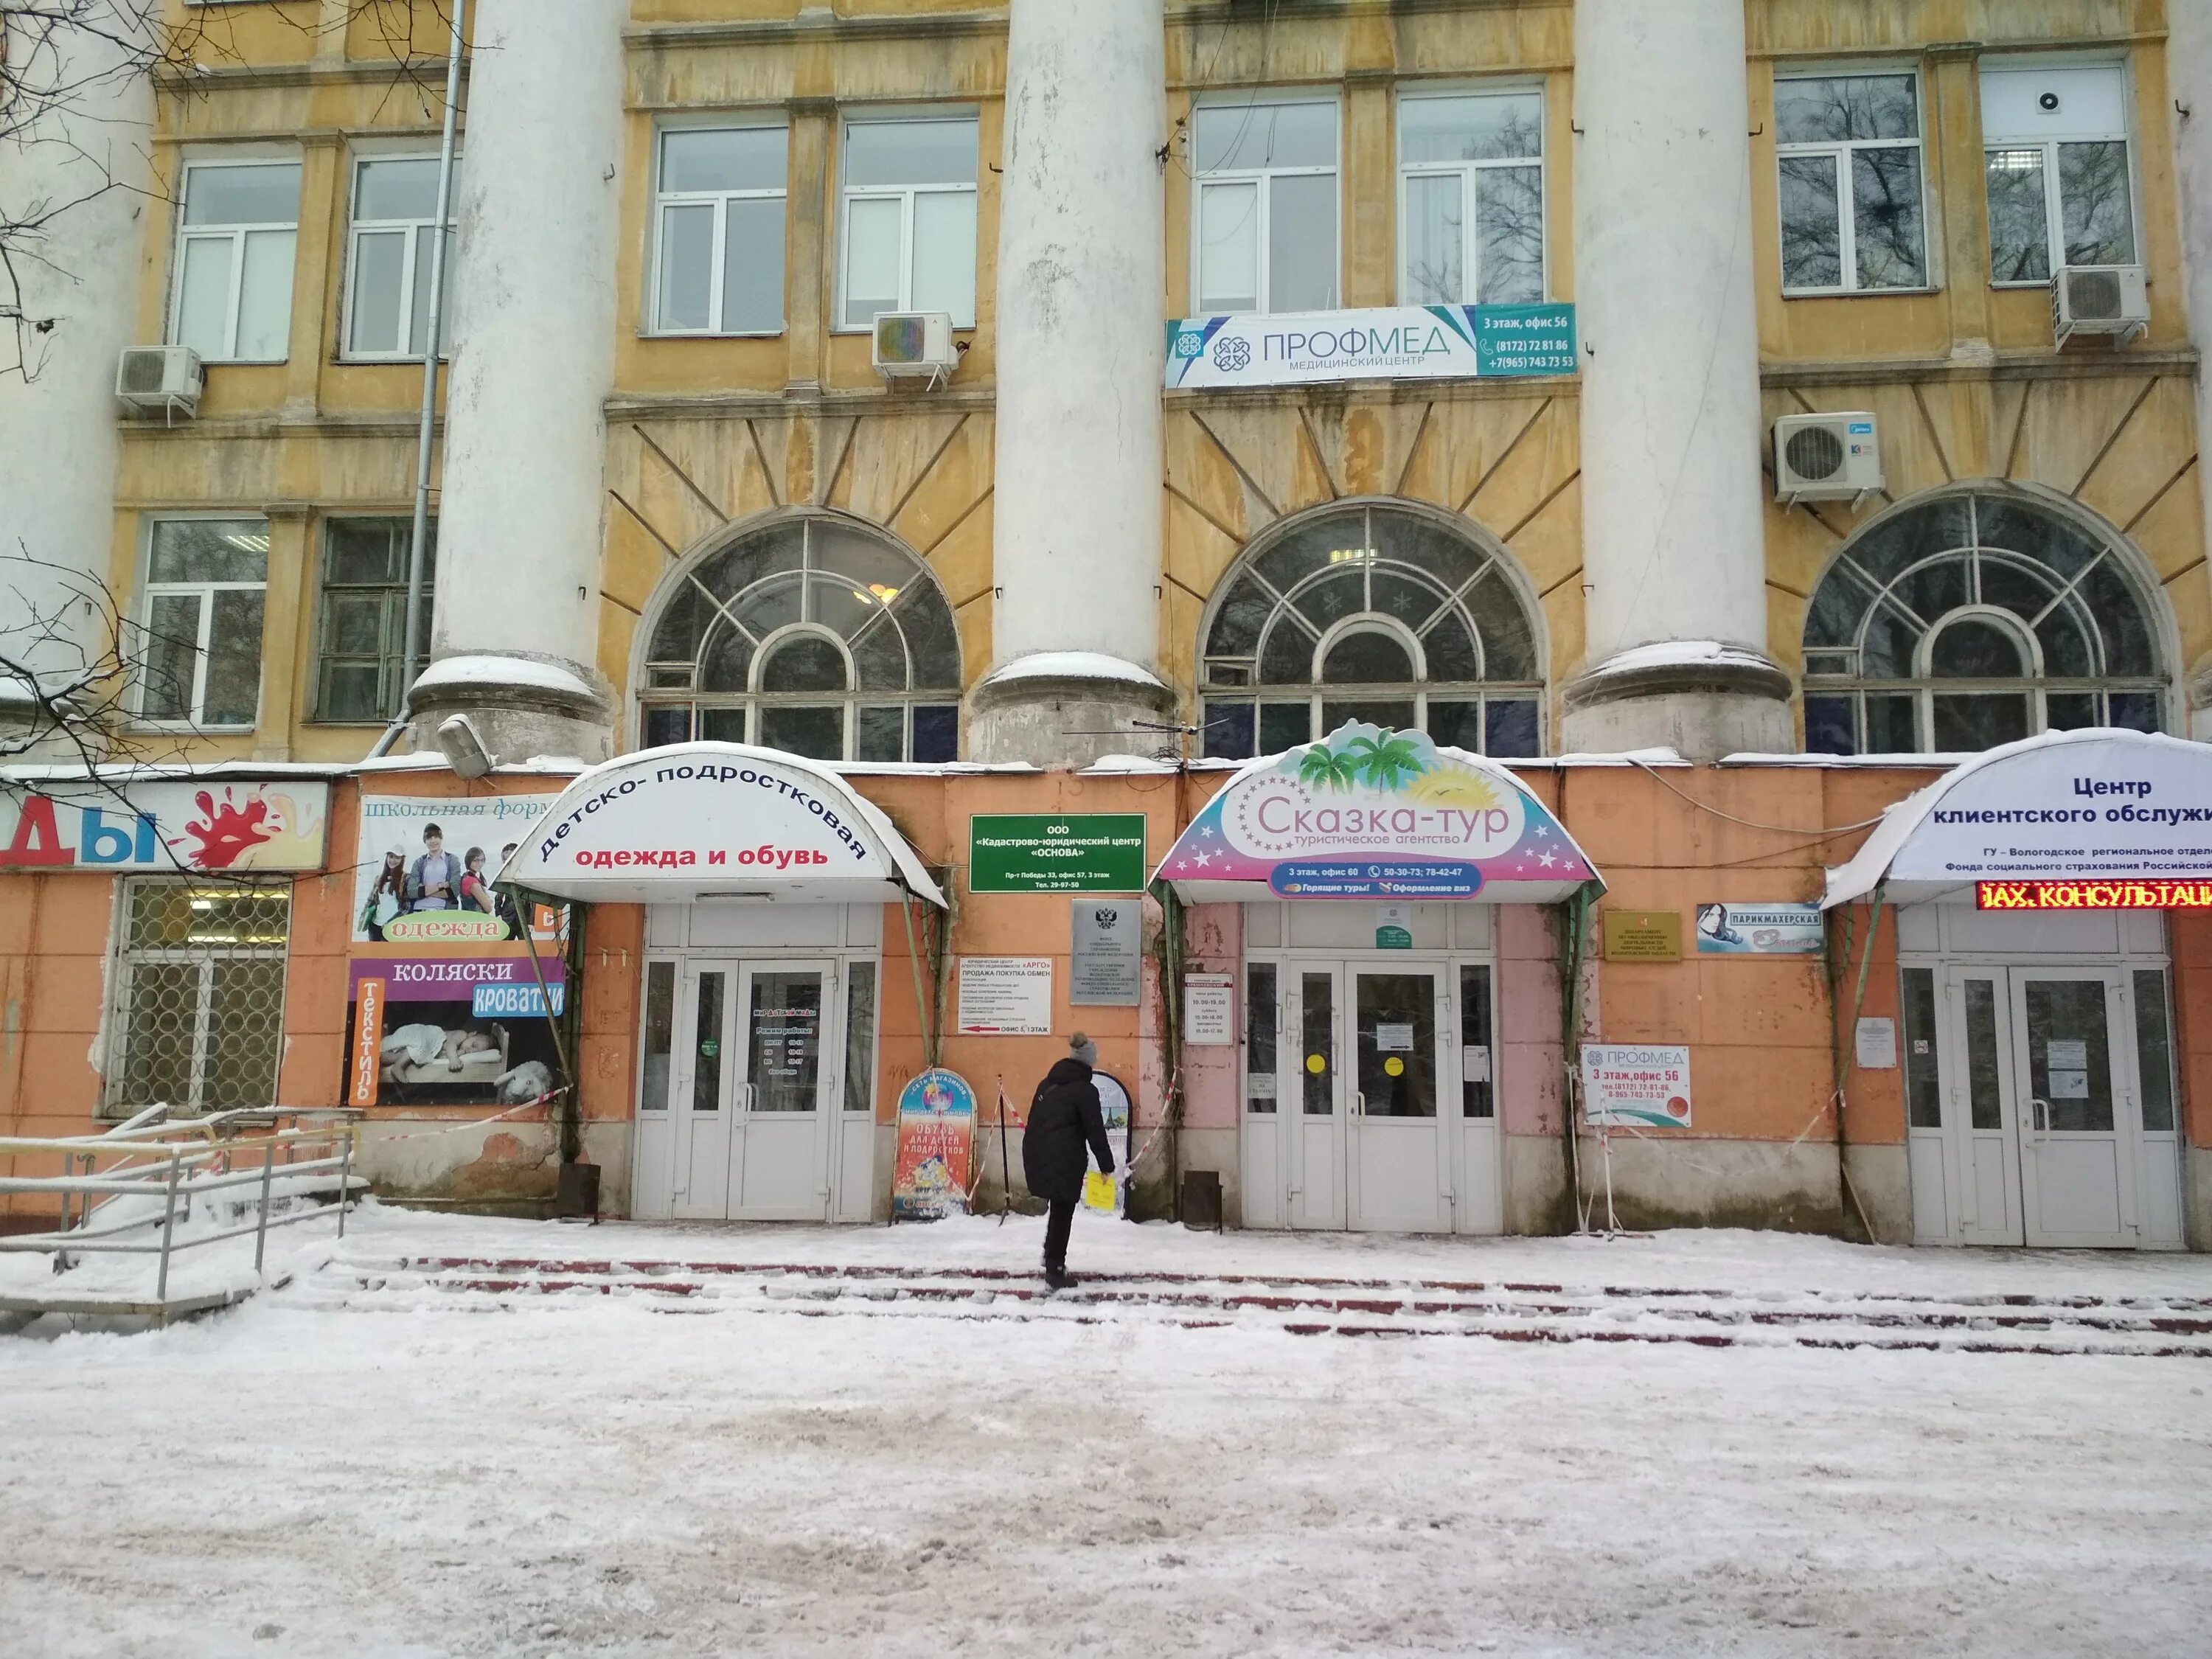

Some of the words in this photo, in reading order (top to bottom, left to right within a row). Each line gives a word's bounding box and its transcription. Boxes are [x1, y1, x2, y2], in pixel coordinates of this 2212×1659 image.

[1484, 318, 1490, 329] 3
[1492, 319, 1523, 330] этаж,
[1526, 316, 1552, 330] офис
[1554, 316, 1568, 327] 56
[1264, 327, 1450, 361] ПРОФМЕД
[1496, 340, 1527, 353] (8172)
[1528, 341, 1540, 351] 72
[1542, 341, 1554, 351] 81
[1556, 340, 1568, 350] 86
[1290, 355, 1382, 370] МЕДИЦИНСКИЙ
[1385, 356, 1425, 366] ЦЕНТР
[1489, 357, 1527, 369] +7(965)
[1528, 357, 1546, 367] 743
[1548, 357, 1559, 367] 73
[1562, 356, 1573, 366] 53
[2074, 778, 2152, 798] Центр
[657, 764, 866, 860] подростковая
[1934, 809, 2096, 824] клиентского
[1258, 796, 1509, 843] Сказка-тур
[1047, 826, 1069, 834] ООО
[976, 837, 1109, 846] «Кадастрово-юридический
[1113, 838, 1141, 846] центр
[1294, 835, 1390, 847] туристическое
[1396, 835, 1460, 844] агентство
[576, 849, 697, 869] одежда
[709, 849, 726, 865] и
[738, 844, 829, 869] обувь
[1032, 849, 1085, 857] «ОСНОВА»
[1983, 848, 1997, 856] ГУ
[2010, 848, 2084, 857] Вологодское
[2092, 848, 2174, 858] региональное
[2177, 848, 2212, 856] отдел
[1296, 869, 1320, 877] этаж,
[1321, 868, 1346, 877] офис
[1384, 868, 1424, 877] 50-30-73;
[1425, 868, 1463, 876] 78-42-47
[1946, 863, 1983, 872] Фонда
[1987, 863, 2062, 872] социального
[2065, 862, 2139, 872] страхования
[2143, 861, 2212, 870] Российской
[1302, 884, 1342, 893] Горящие
[1343, 884, 1370, 893] туры!
[1393, 884, 1452, 893] Оформление
[392, 922, 499, 940] одежда
[1607, 1051, 1684, 1064] ПРОФМЕД
[1593, 1069, 1599, 1079] 3
[1665, 1071, 1679, 1081] 56
[911, 1079, 928, 1092] СЕТЬ
